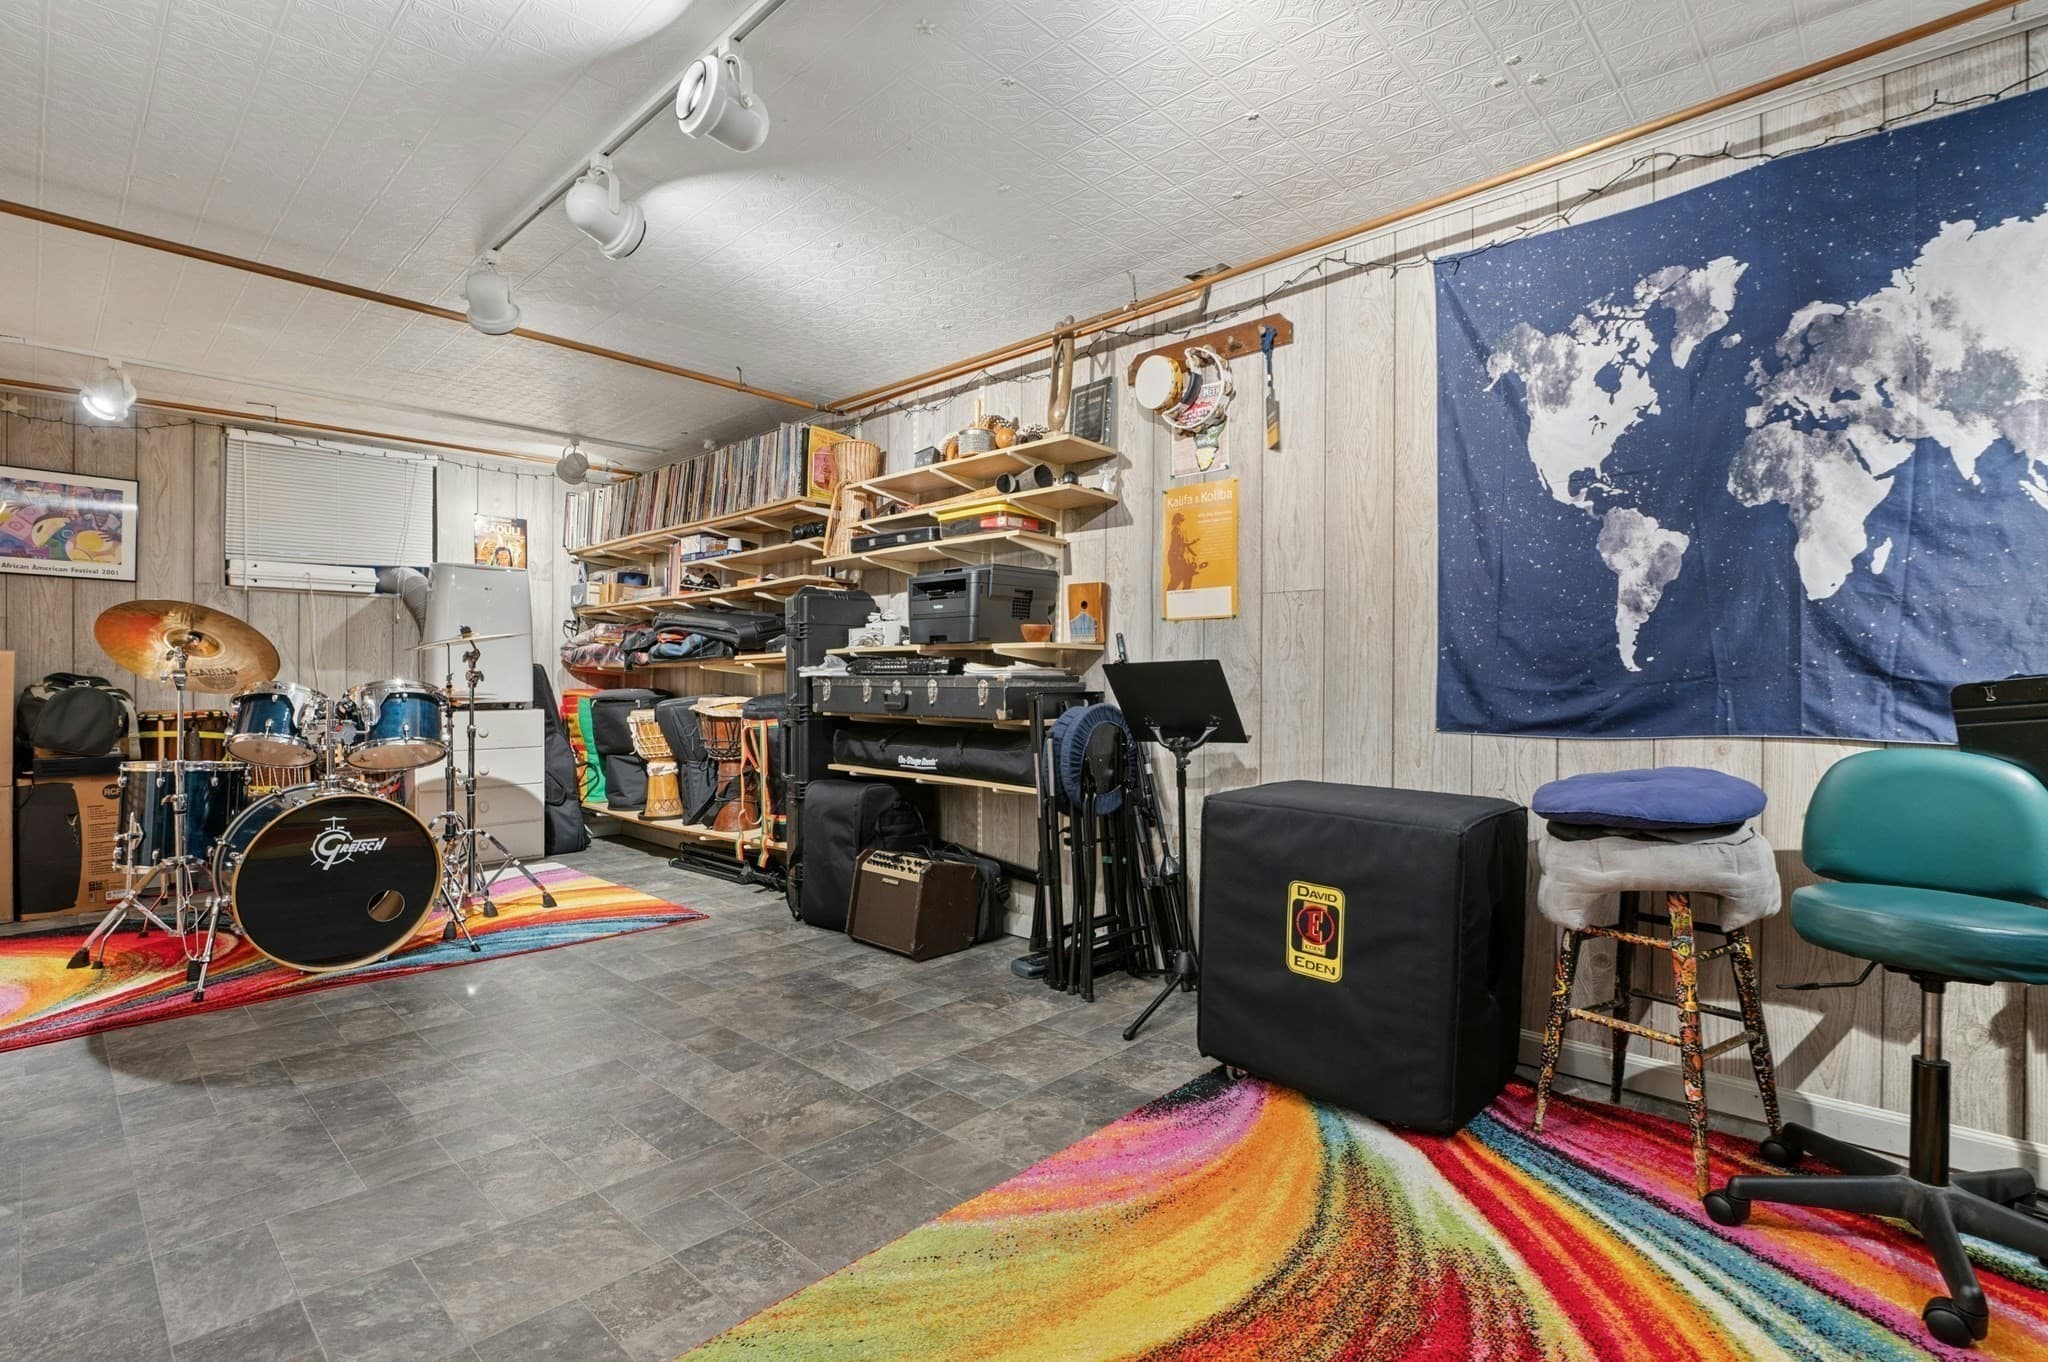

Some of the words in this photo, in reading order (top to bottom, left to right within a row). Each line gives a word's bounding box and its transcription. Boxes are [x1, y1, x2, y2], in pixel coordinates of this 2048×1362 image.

[1, 562, 29, 570] African
[32, 564, 68, 573] American
[71, 567, 99, 575] Festival
